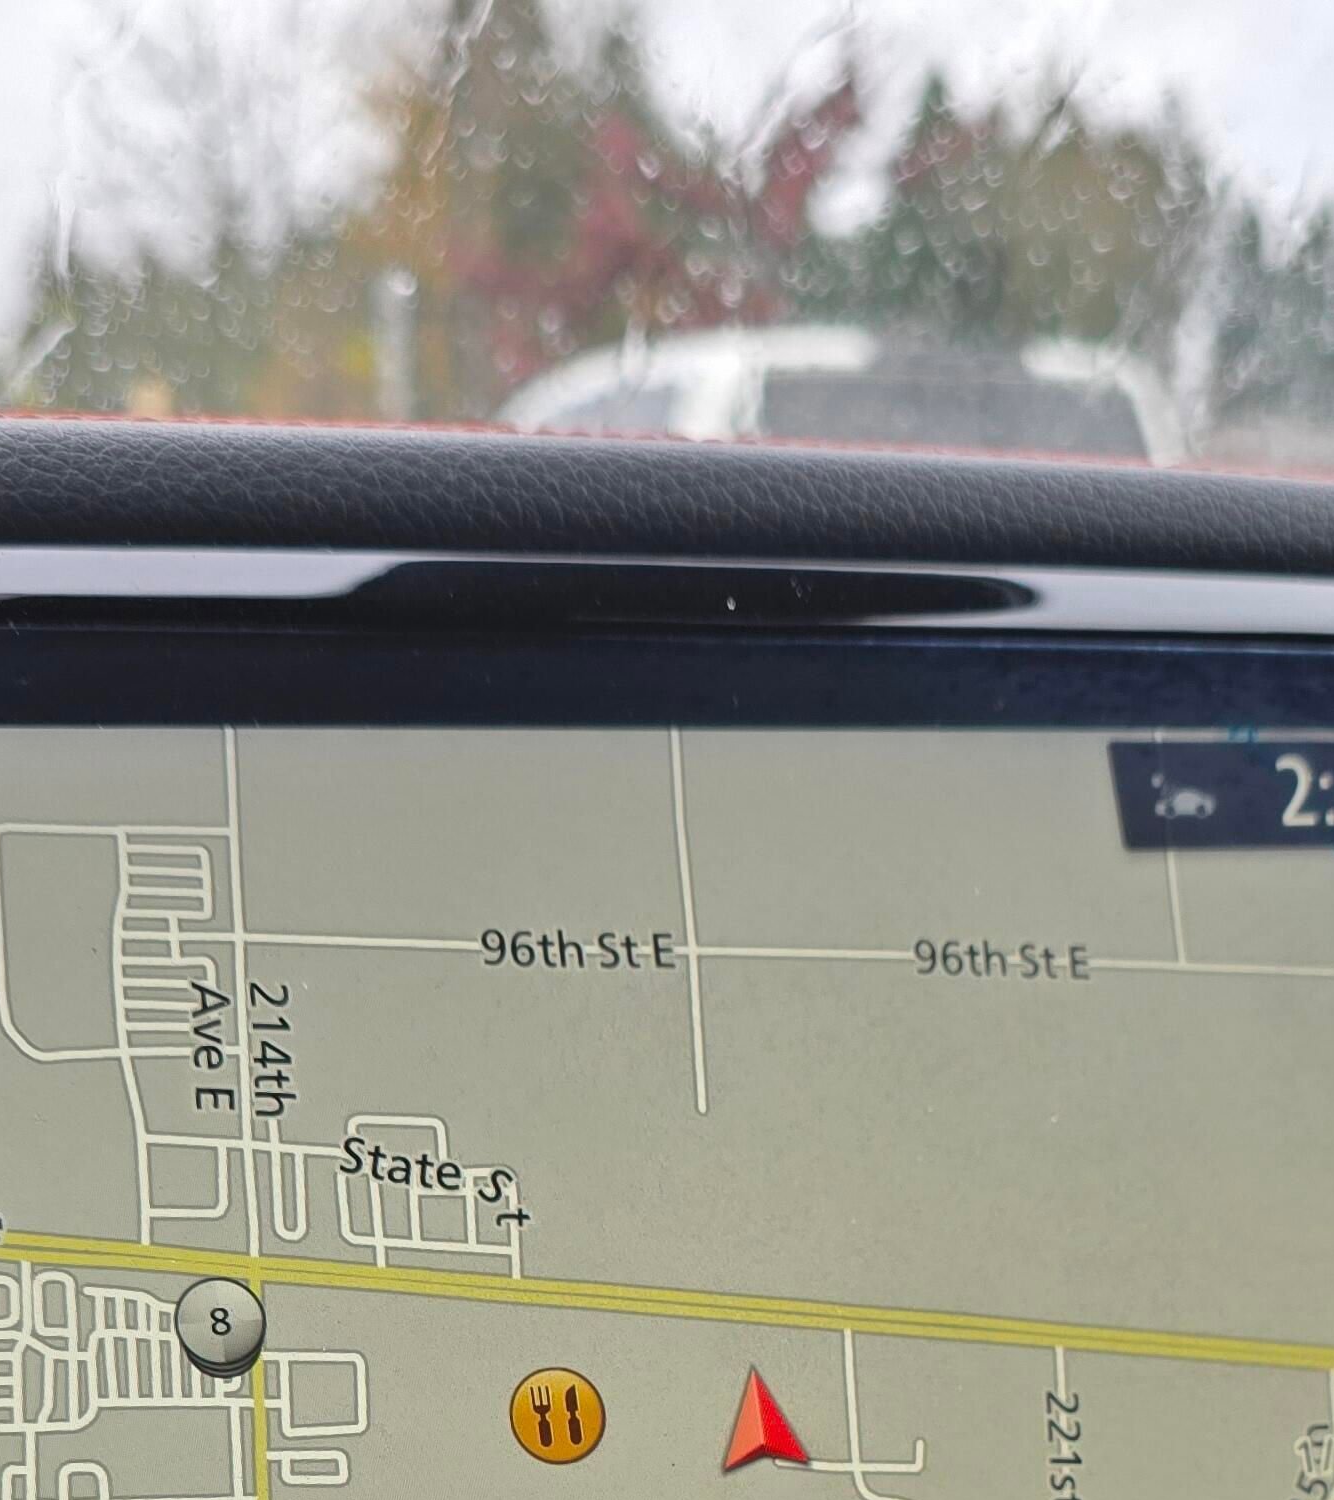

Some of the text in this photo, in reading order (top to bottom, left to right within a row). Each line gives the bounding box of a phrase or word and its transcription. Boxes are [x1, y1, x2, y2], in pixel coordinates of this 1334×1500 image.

[479, 928, 676, 968] 96th St E
[914, 940, 1090, 980] 96th St E
[190, 980, 235, 1111] Ave E
[249, 984, 297, 1118] 214th
[340, 1137, 531, 1227] State St
[211, 1307, 232, 1336] 8
